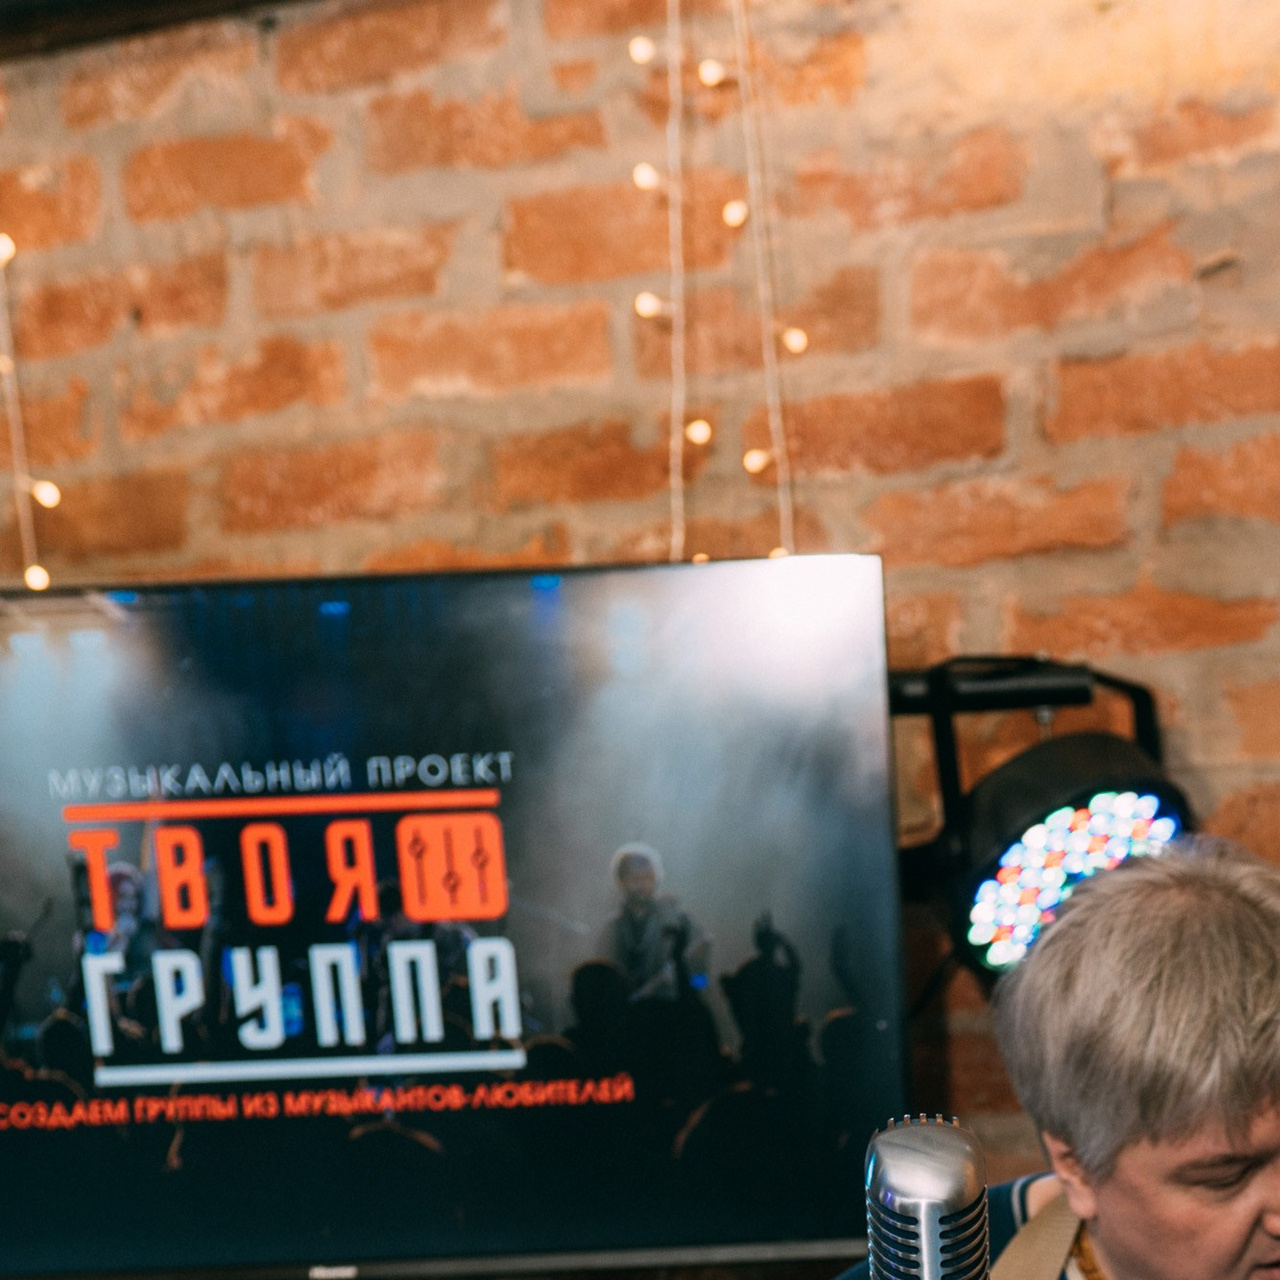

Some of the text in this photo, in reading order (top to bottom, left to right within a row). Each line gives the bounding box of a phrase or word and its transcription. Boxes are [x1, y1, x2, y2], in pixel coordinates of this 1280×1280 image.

[48, 751, 516, 798] МУЗЫКАЛЬНЫЙ ПРОЕКТ
[68, 819, 380, 932] ТВОЯ
[82, 936, 523, 1057] ГРУППА
[134, 1094, 237, 1122] ГРУППЫ
[242, 1091, 279, 1117] ИЗ
[283, 1072, 635, 1117] МУЗЫКАНТОВ-ЛЮБИТЕЛЕЙ
